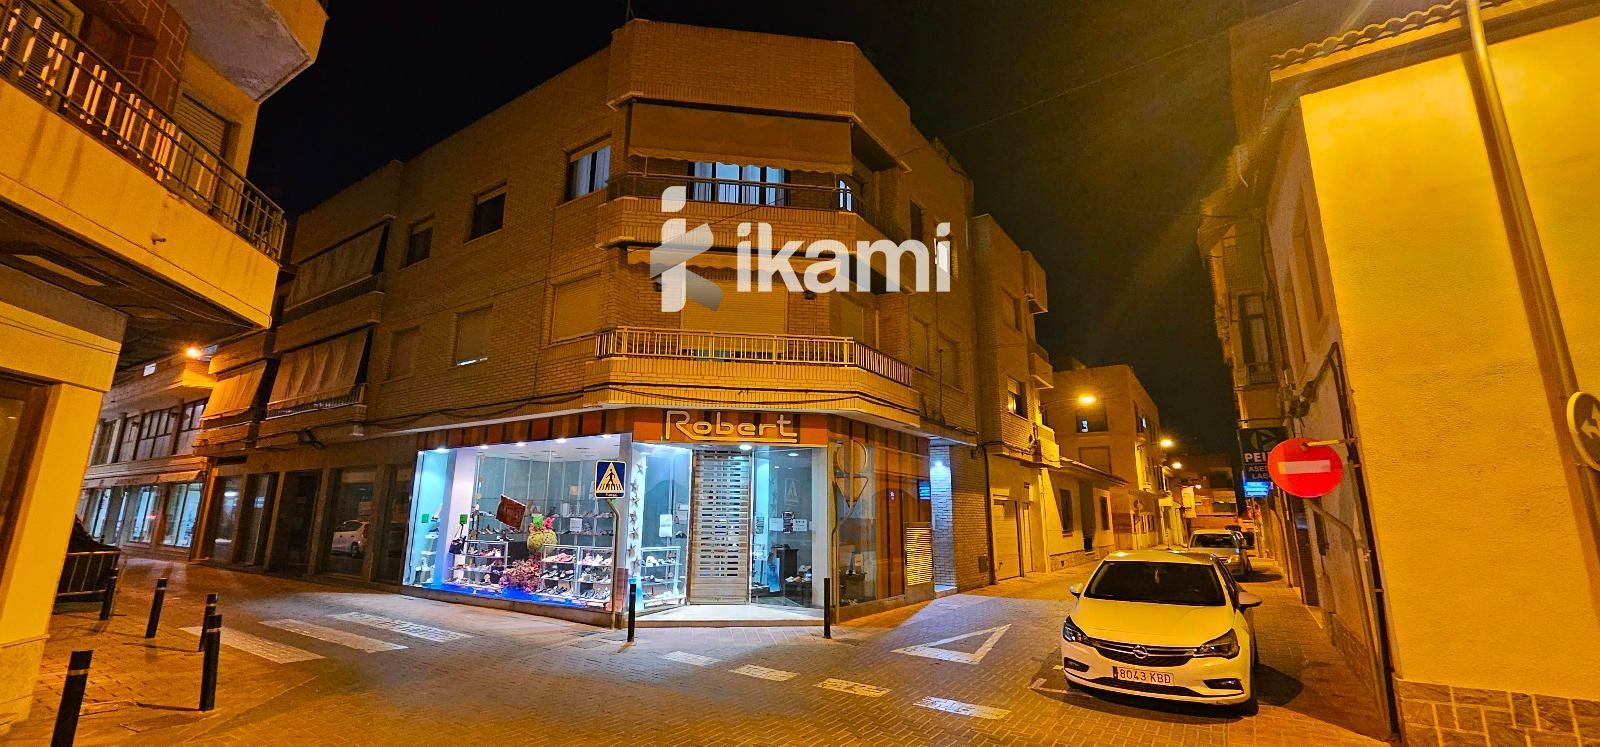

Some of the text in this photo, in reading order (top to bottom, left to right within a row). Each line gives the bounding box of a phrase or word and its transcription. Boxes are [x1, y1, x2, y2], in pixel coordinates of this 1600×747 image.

[665, 410, 798, 443] Robert
[1119, 669, 1171, 684] 8043 KBD
